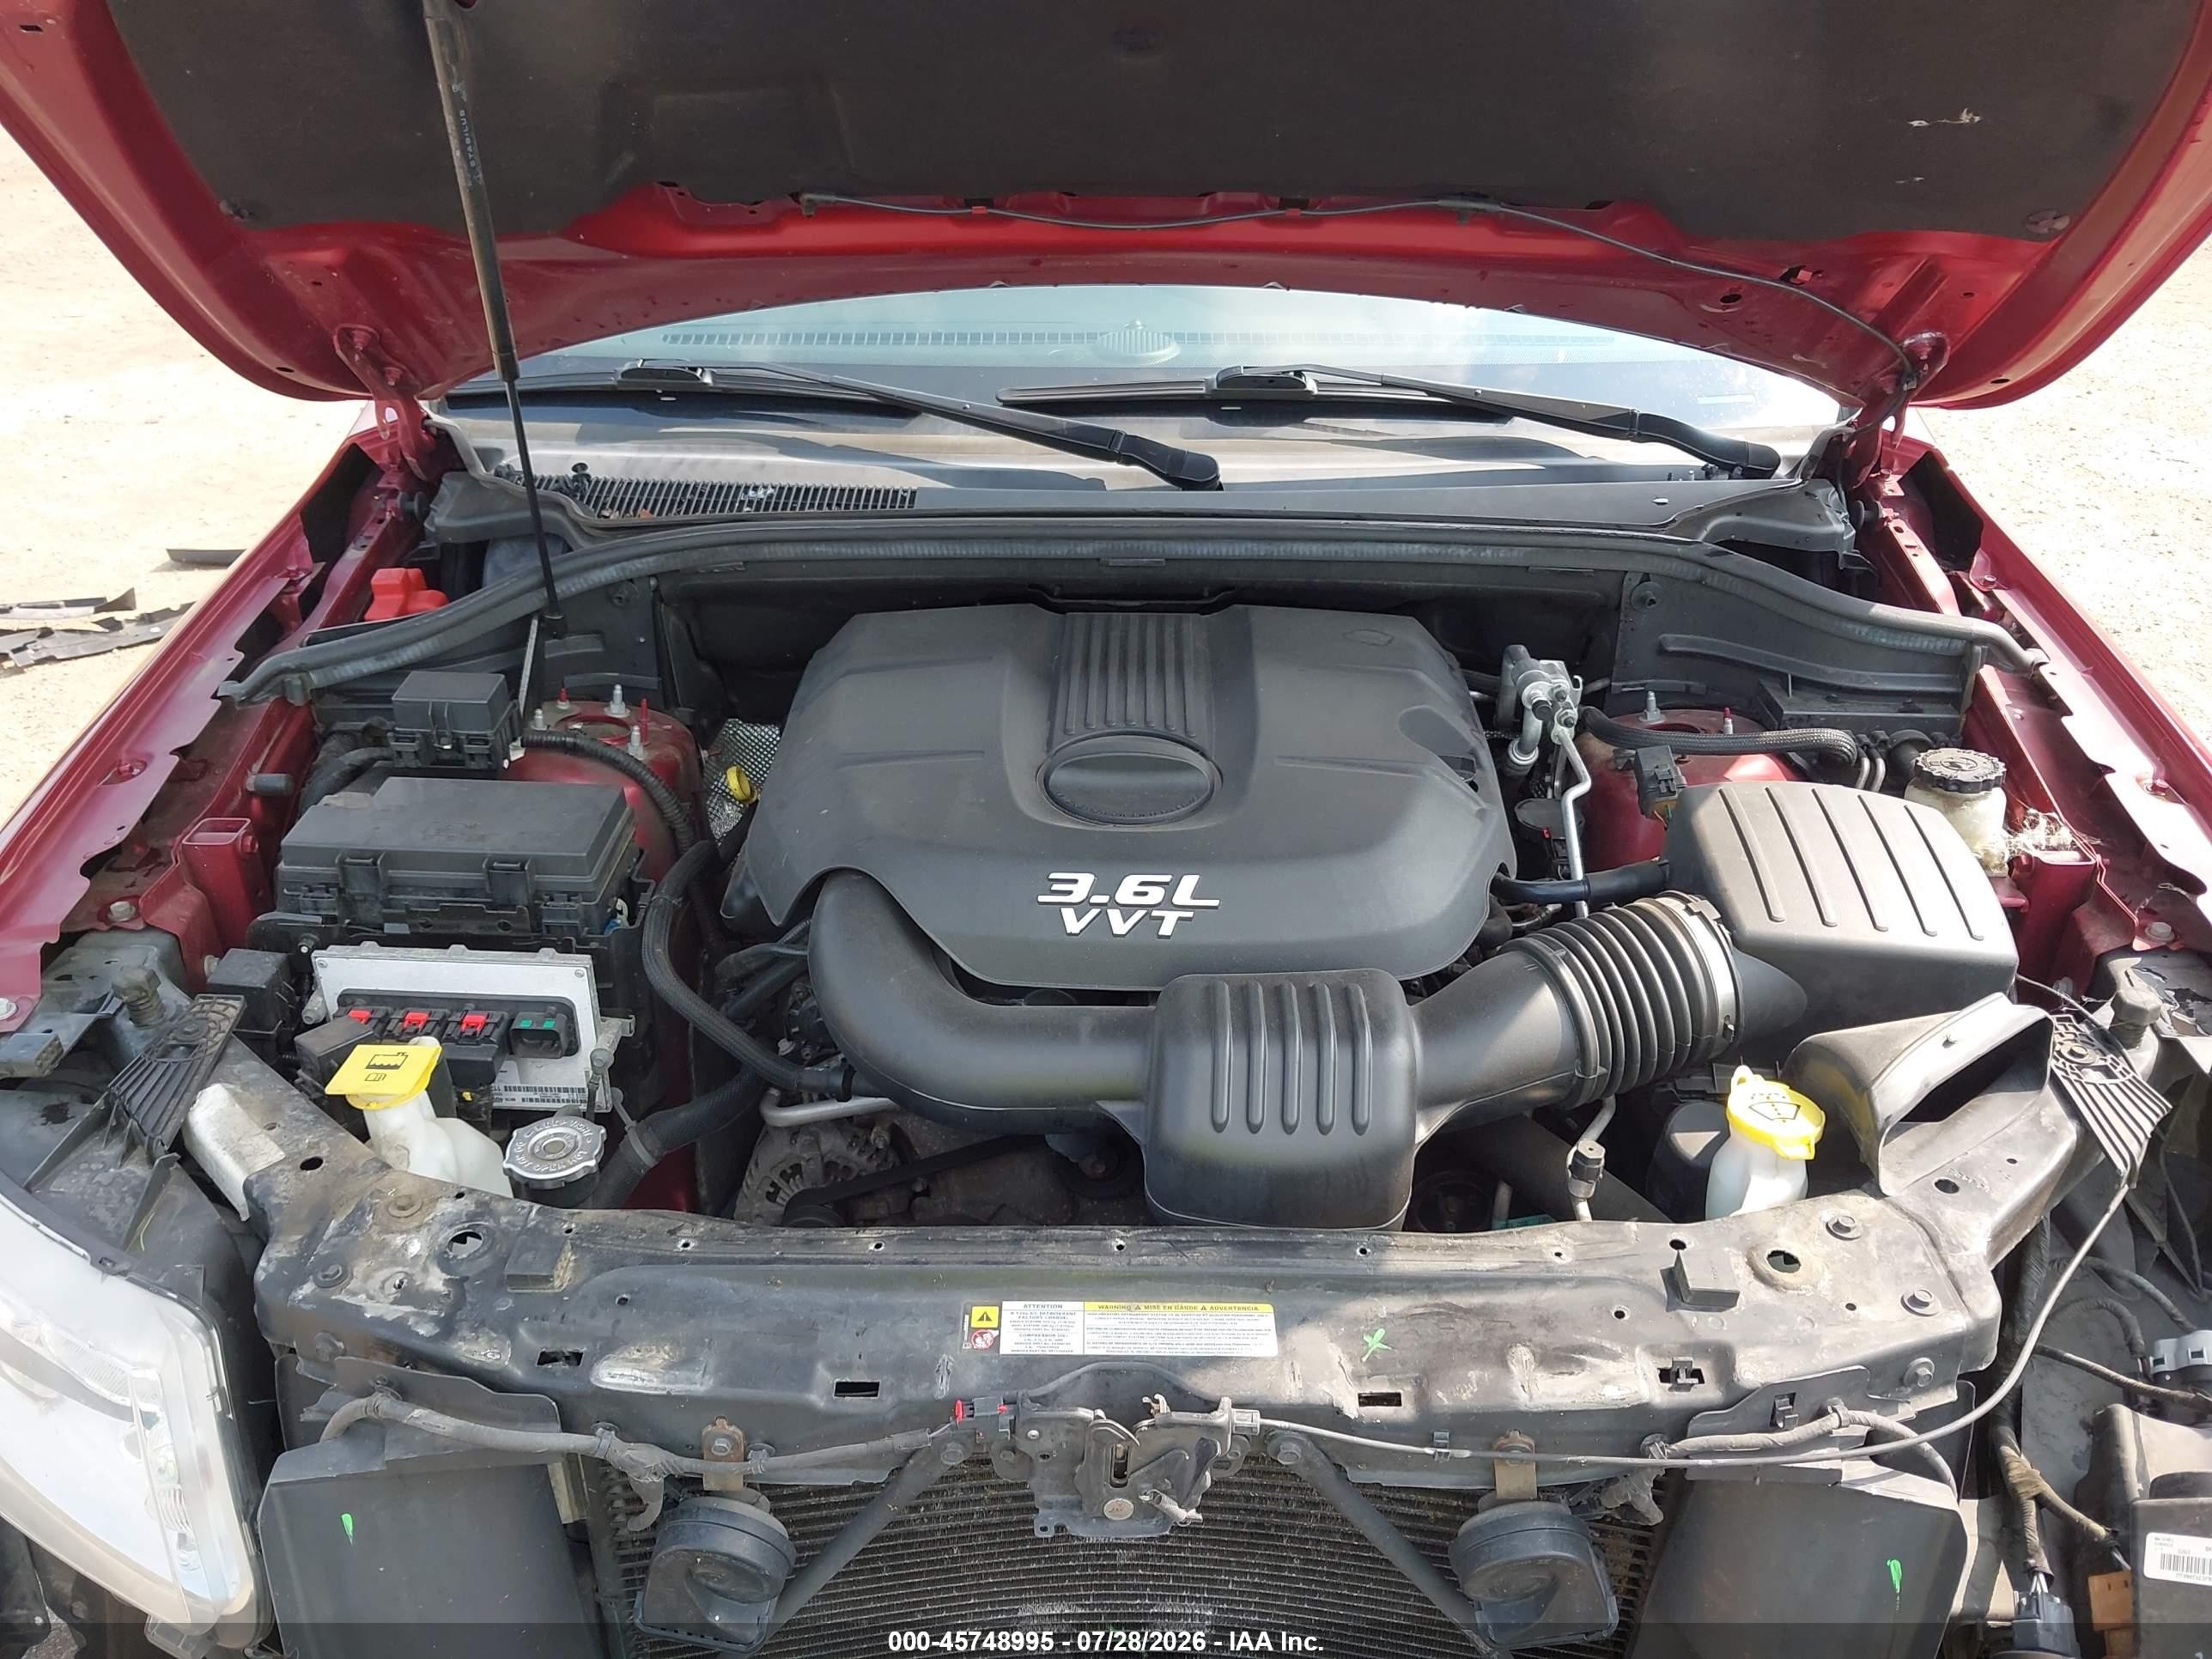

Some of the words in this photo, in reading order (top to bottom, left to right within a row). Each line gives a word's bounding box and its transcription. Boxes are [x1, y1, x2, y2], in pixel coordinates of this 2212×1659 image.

[459, 109, 476, 167] STABILUS
[1036, 872, 1220, 908] 3.6L
[1060, 907, 1194, 938] VVT
